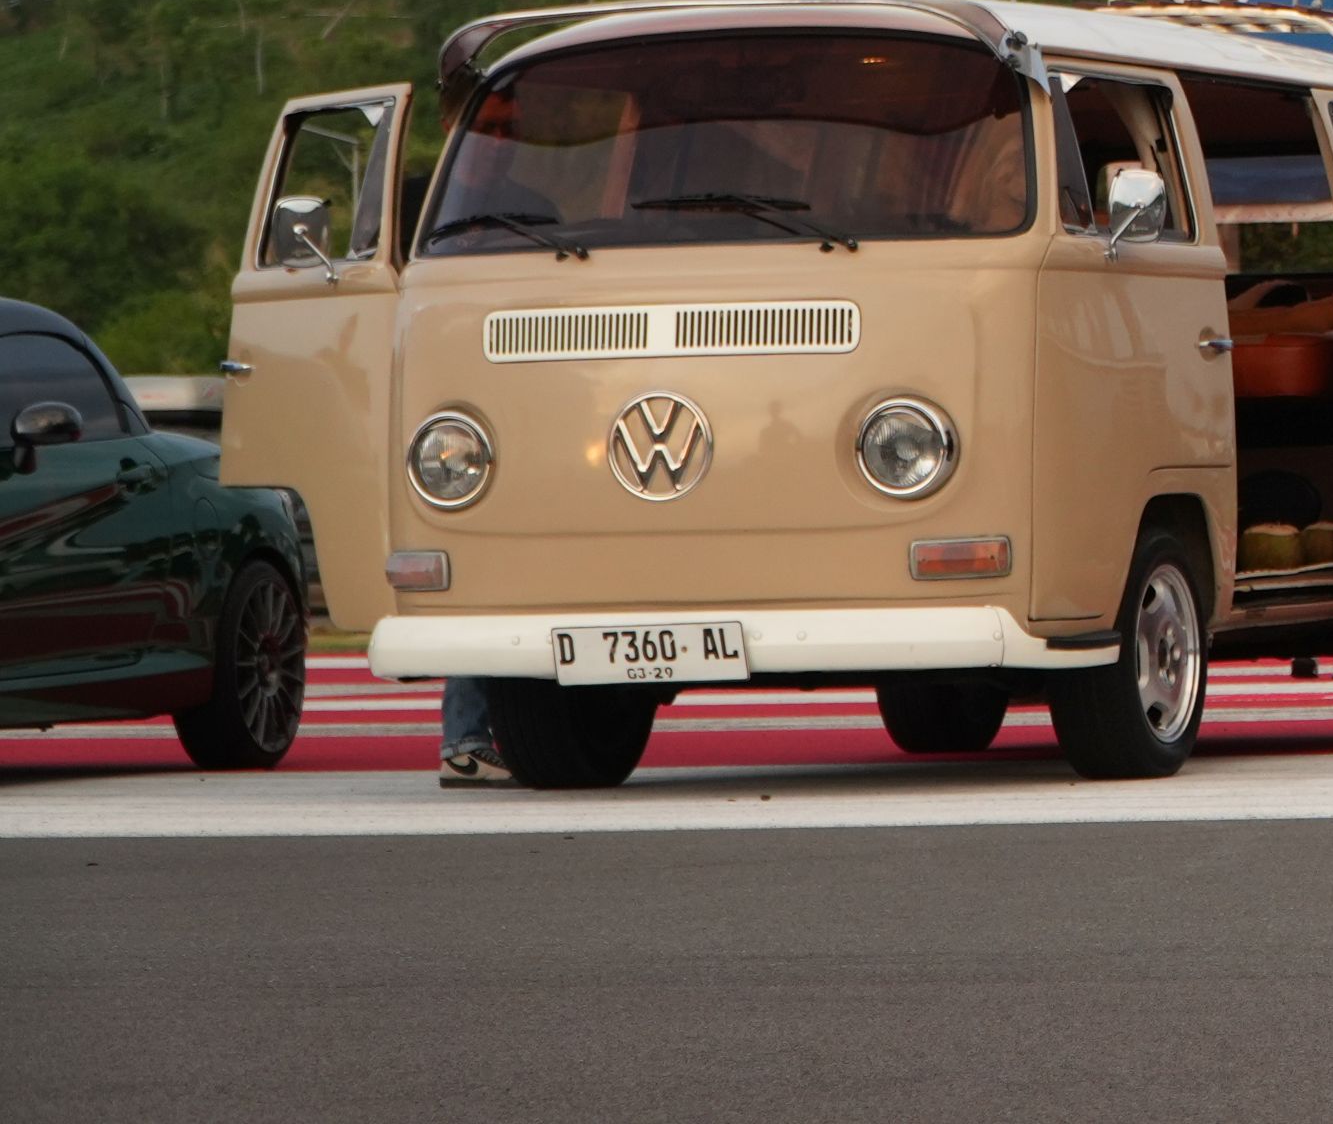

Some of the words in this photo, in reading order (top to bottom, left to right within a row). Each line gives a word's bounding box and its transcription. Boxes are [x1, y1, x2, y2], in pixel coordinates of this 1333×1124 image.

[557, 633, 575, 665] D
[602, 630, 677, 663] 7360
[703, 628, 739, 660] AL
